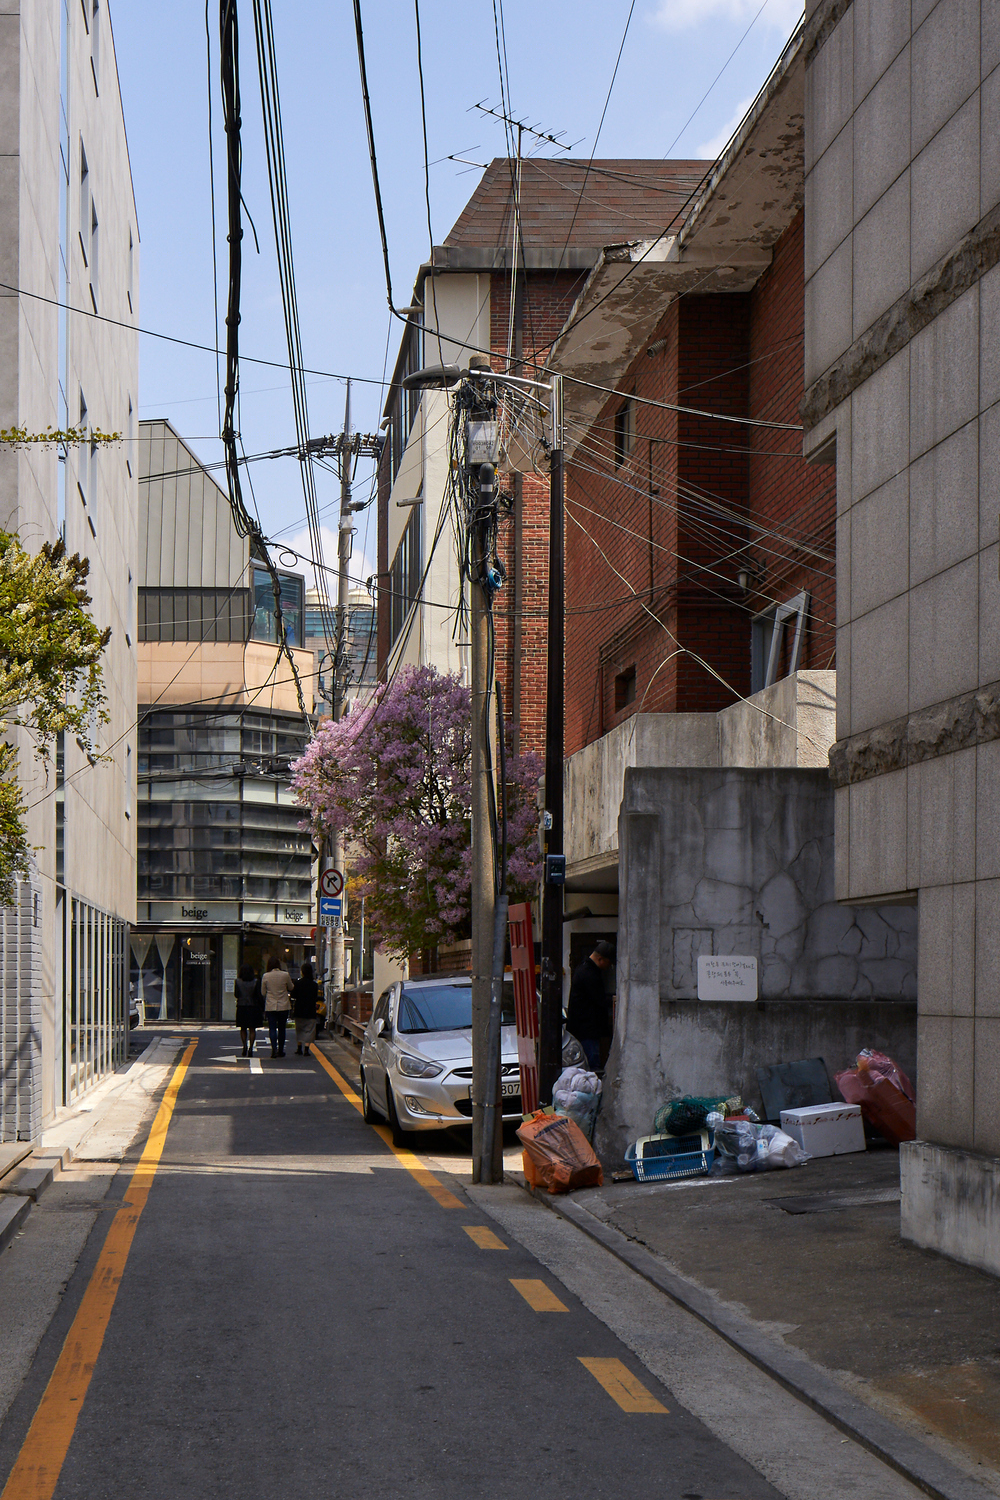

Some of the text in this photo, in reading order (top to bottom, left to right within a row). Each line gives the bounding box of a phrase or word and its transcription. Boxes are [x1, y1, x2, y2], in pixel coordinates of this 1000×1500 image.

[181, 906, 208, 920] beige
[285, 908, 304, 922] beige
[190, 951, 208, 961] beige
